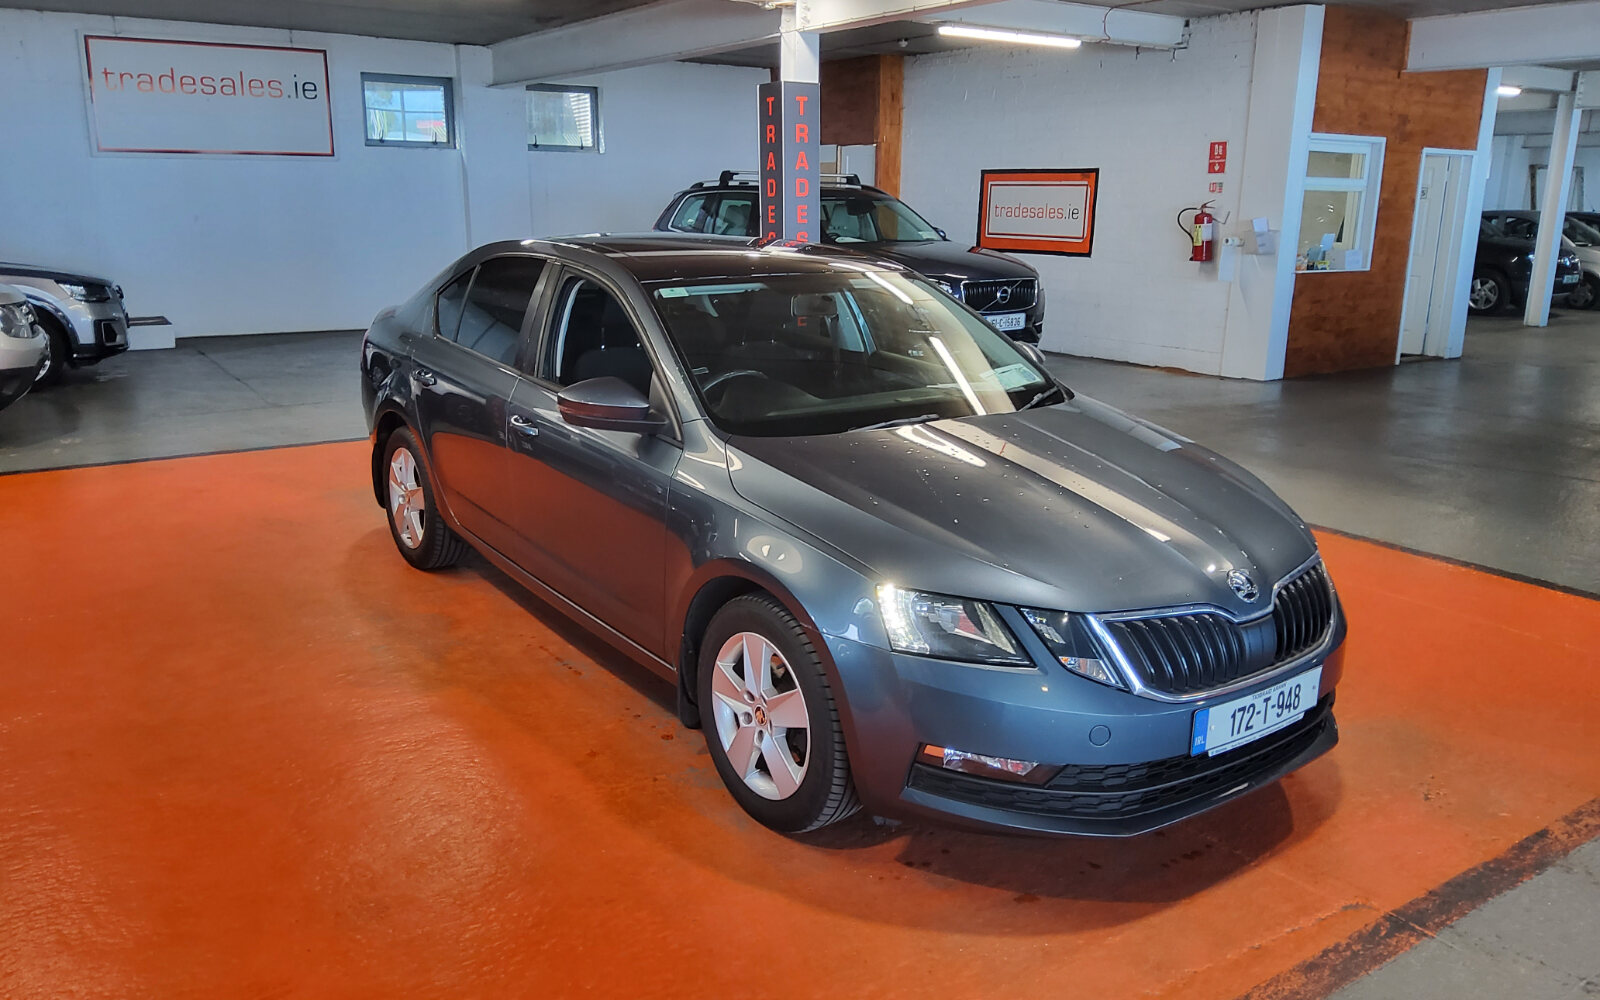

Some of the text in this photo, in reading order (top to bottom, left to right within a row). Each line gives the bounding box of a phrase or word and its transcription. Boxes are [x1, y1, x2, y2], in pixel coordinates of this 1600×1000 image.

[101, 67, 318, 100] tradesales.ie
[994, 203, 1080, 220] tradesales.ie
[1230, 683, 1302, 737] 172-T-948
[1194, 735, 1205, 747] IRL
